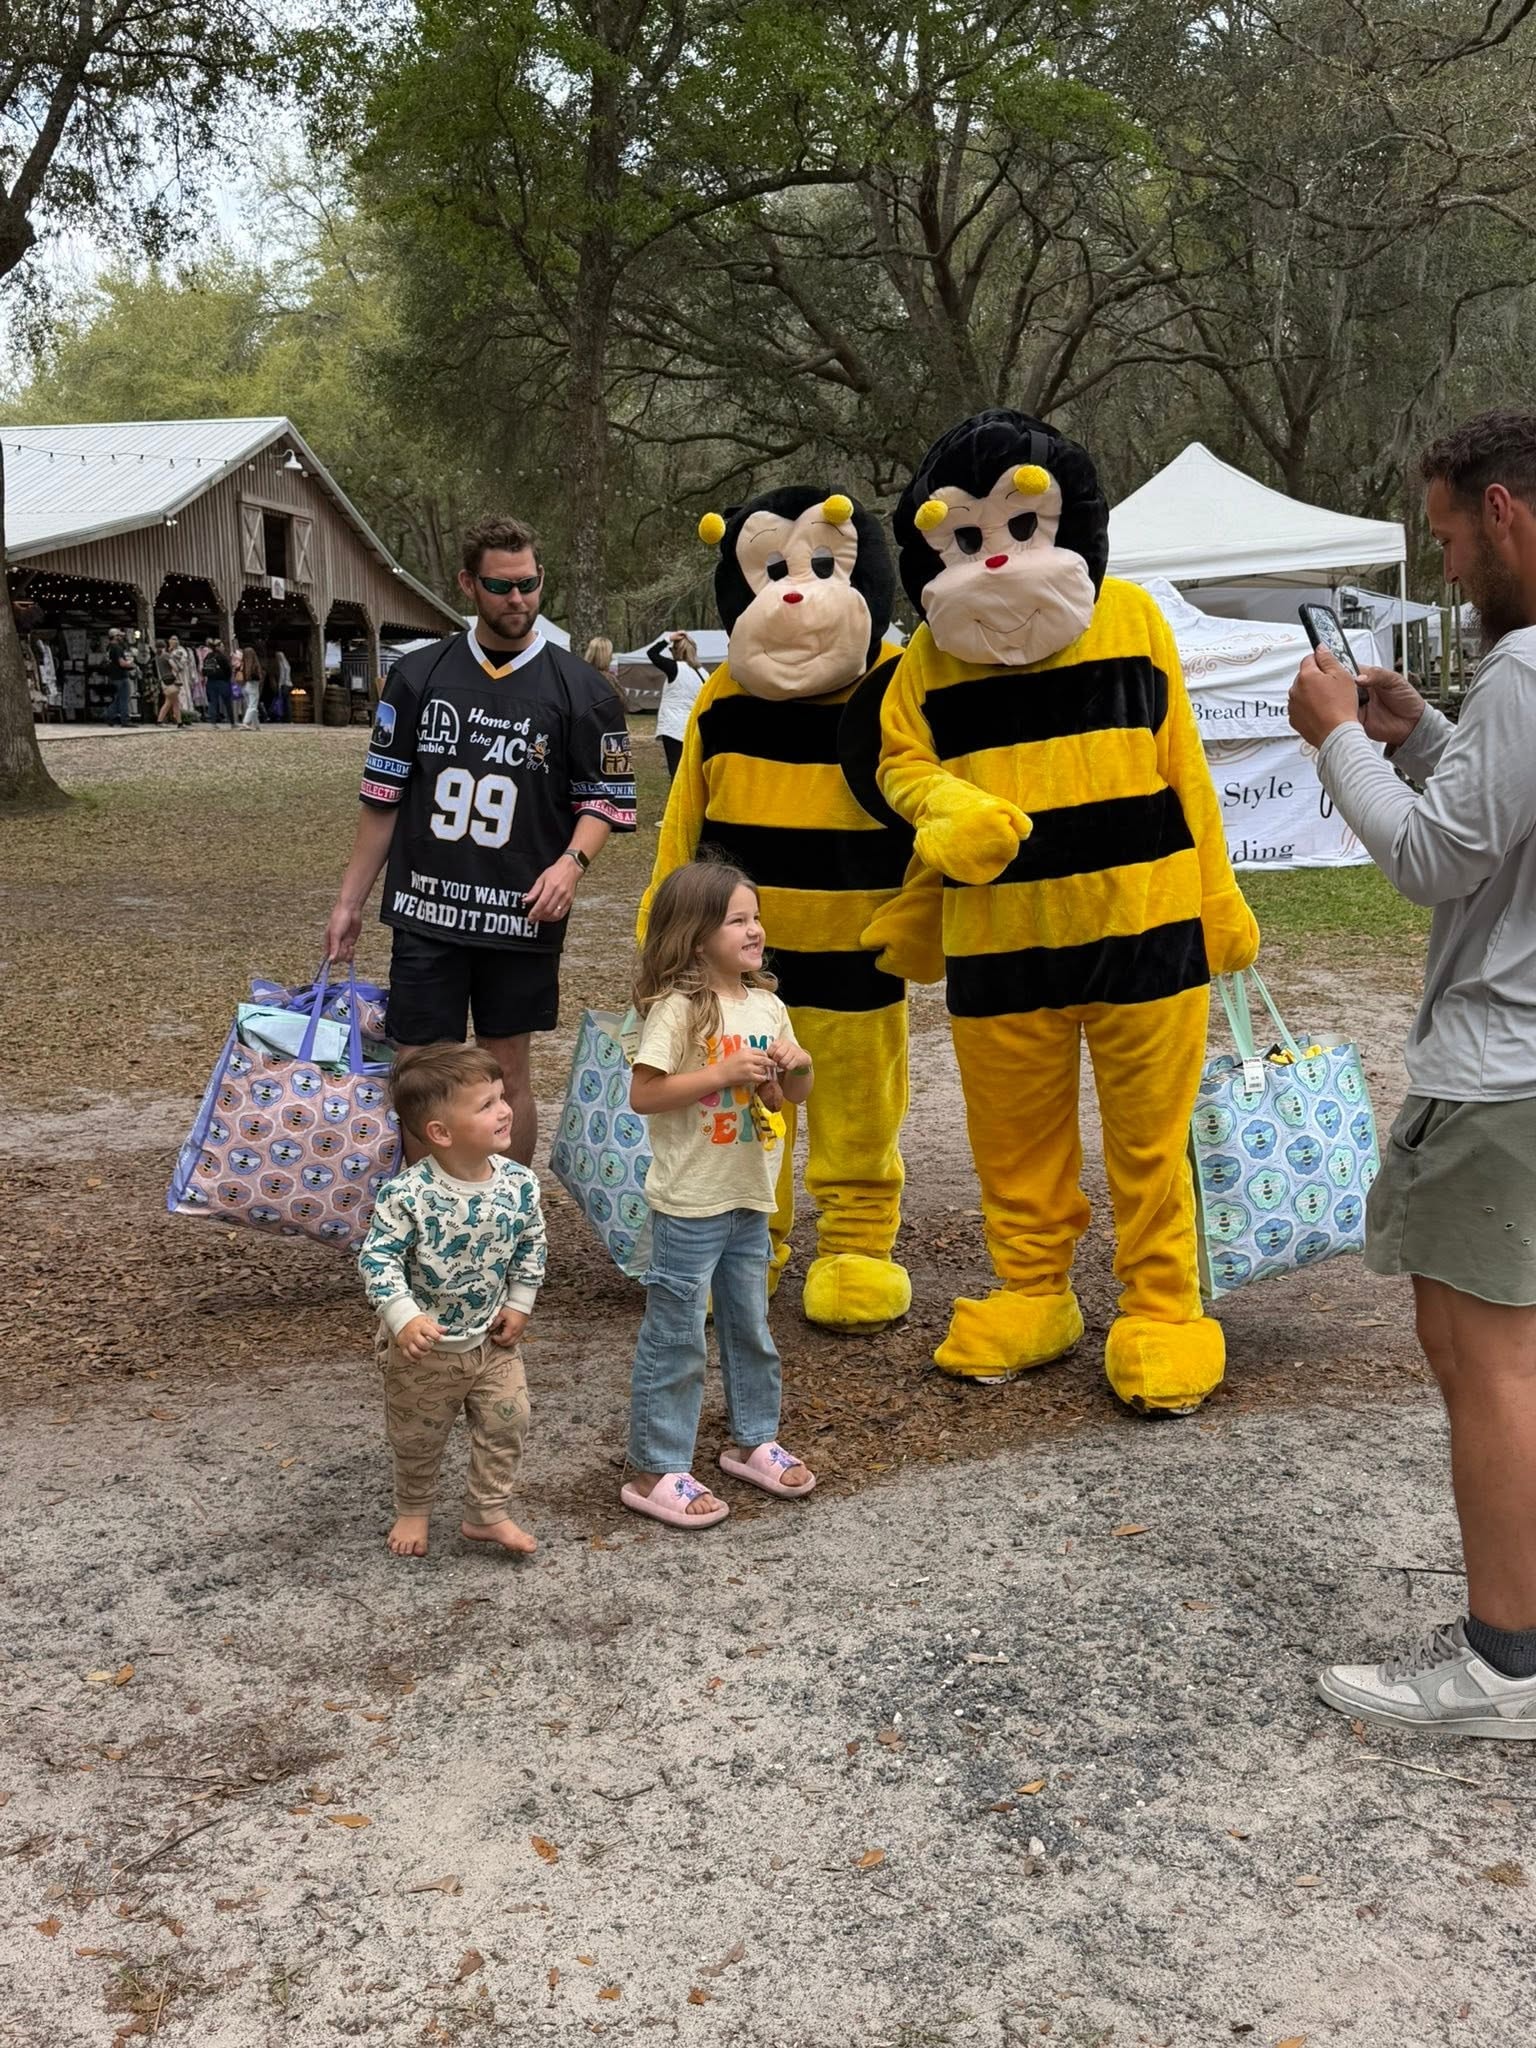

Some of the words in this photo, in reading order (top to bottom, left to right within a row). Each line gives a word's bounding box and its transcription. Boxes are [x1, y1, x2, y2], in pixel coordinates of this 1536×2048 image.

[467, 707, 512, 729] Home
[513, 717, 531, 736] of
[417, 742, 445, 754] uble
[447, 744, 458, 756] A
[469, 730, 492, 747] the
[482, 735, 527, 767] AC
[384, 761, 409, 775] PLUM
[1223, 775, 1294, 809] Style
[429, 766, 518, 849] 99
[1227, 839, 1295, 864] ding
[440, 879, 472, 902] YOU
[392, 890, 418, 917] WE
[458, 908, 481, 932] IT
